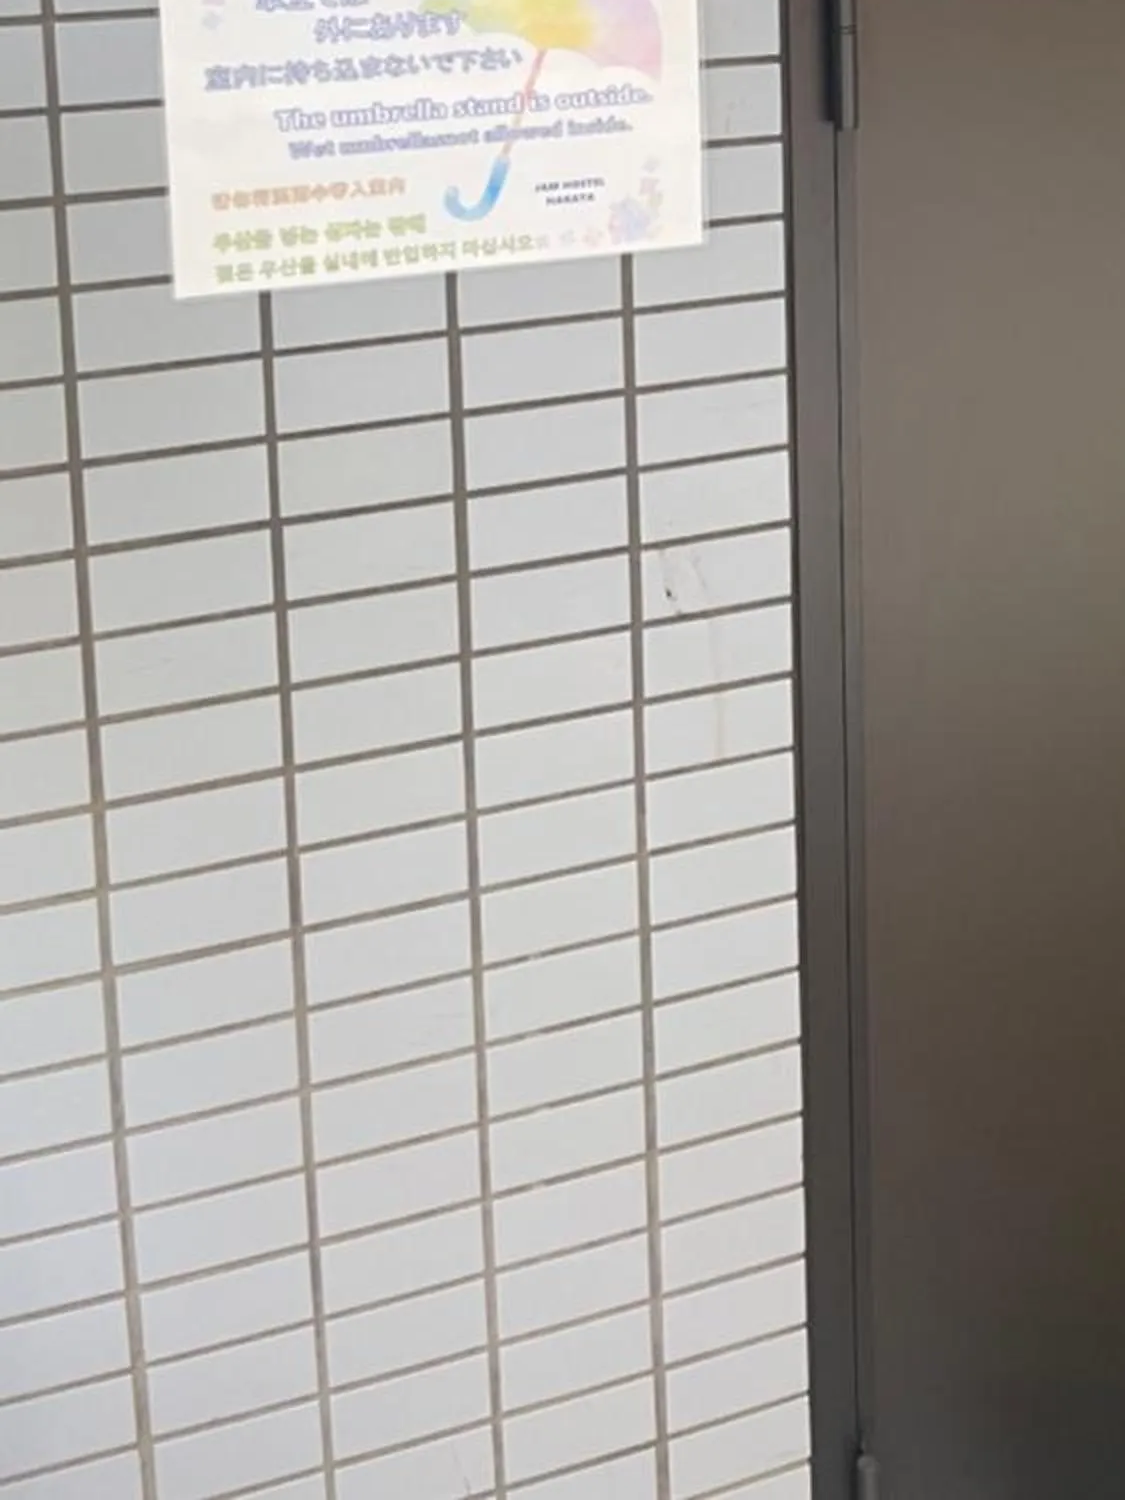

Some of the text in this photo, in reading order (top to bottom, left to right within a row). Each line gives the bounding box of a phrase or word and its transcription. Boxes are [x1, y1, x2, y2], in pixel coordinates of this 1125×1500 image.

[273, 107, 327, 132] The
[330, 98, 448, 128] umbrella
[452, 92, 525, 118] stand
[529, 90, 550, 112] is
[288, 140, 336, 160] Wet
[535, 176, 607, 193] JAM HOSTEL
